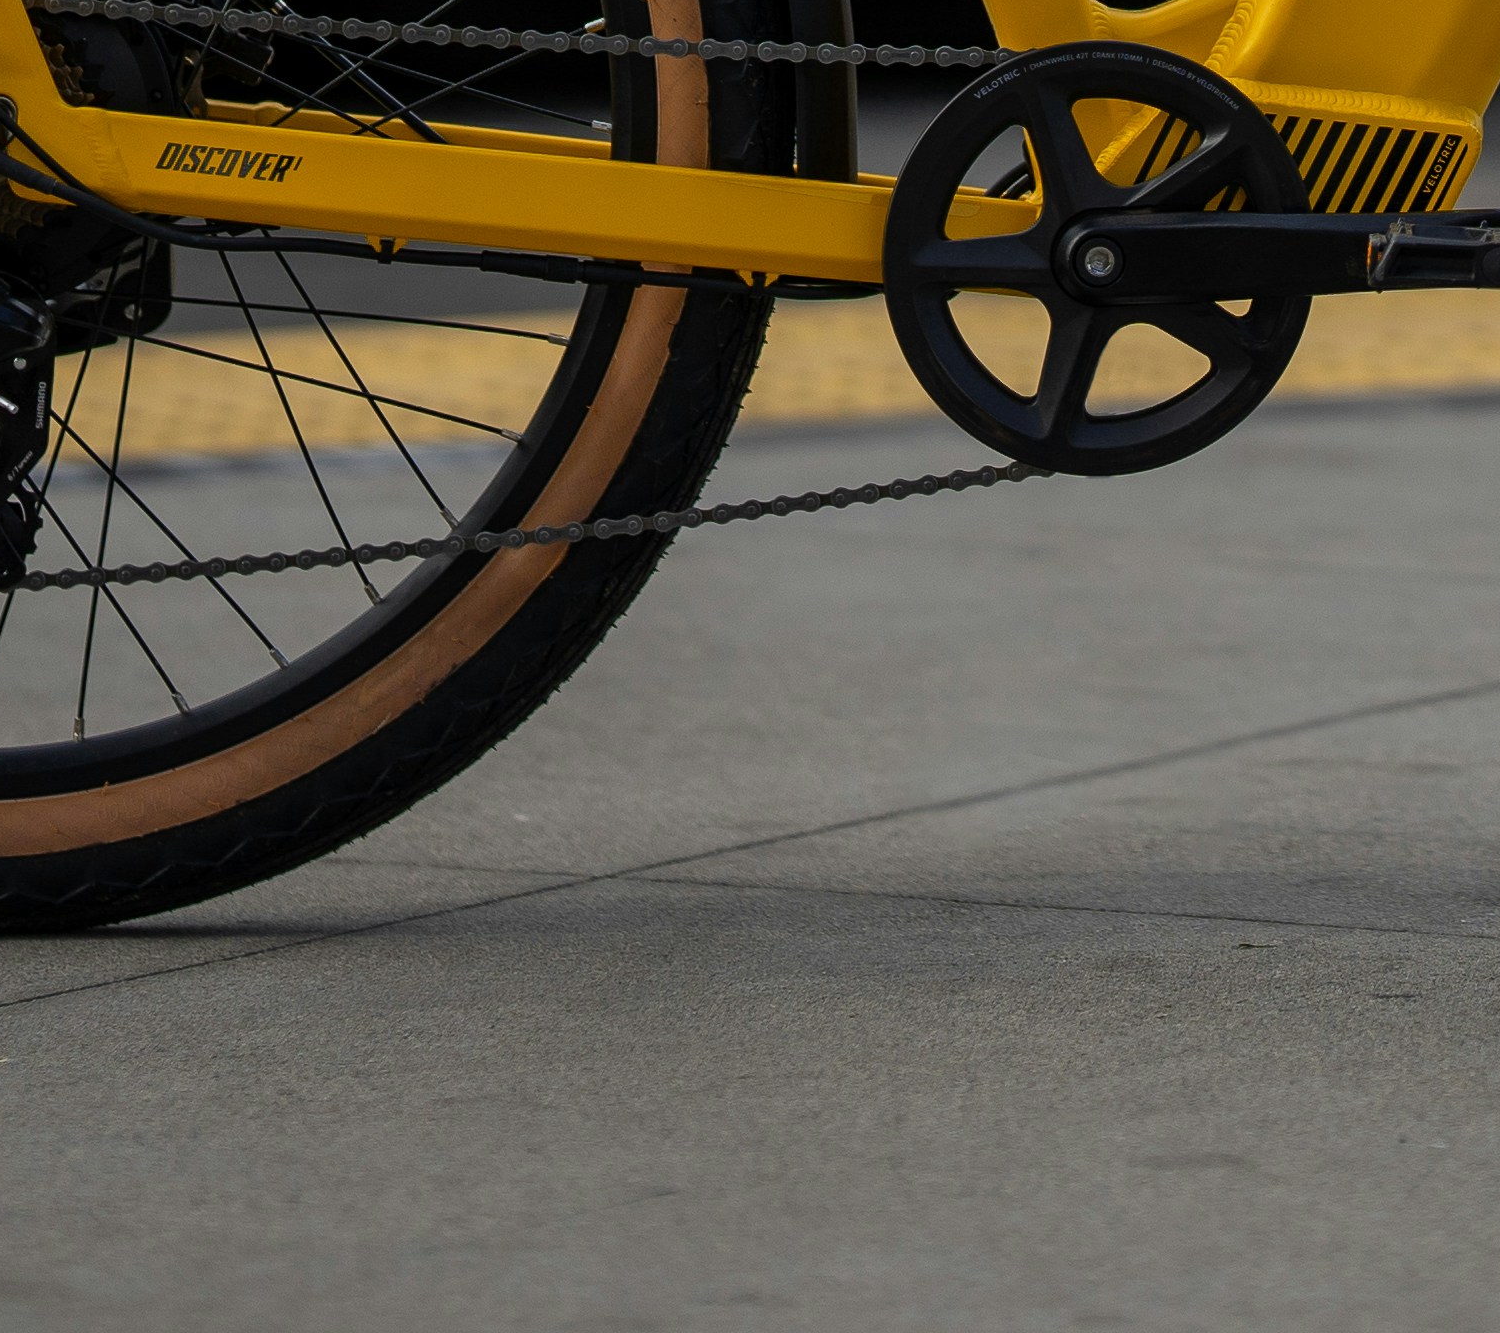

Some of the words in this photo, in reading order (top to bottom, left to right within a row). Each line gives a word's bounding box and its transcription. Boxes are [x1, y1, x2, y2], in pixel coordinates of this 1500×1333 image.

[973, 68, 1021, 100] VELOTRIC
[1029, 55, 1074, 71] CHAINWHEEL
[1092, 51, 1116, 59] CRANK
[1152, 58, 1186, 77] DESIGNED
[1186, 71, 1197, 82] BY
[1422, 138, 1457, 193] VELOTRIC
[35, 381, 47, 429] SHIMANO
